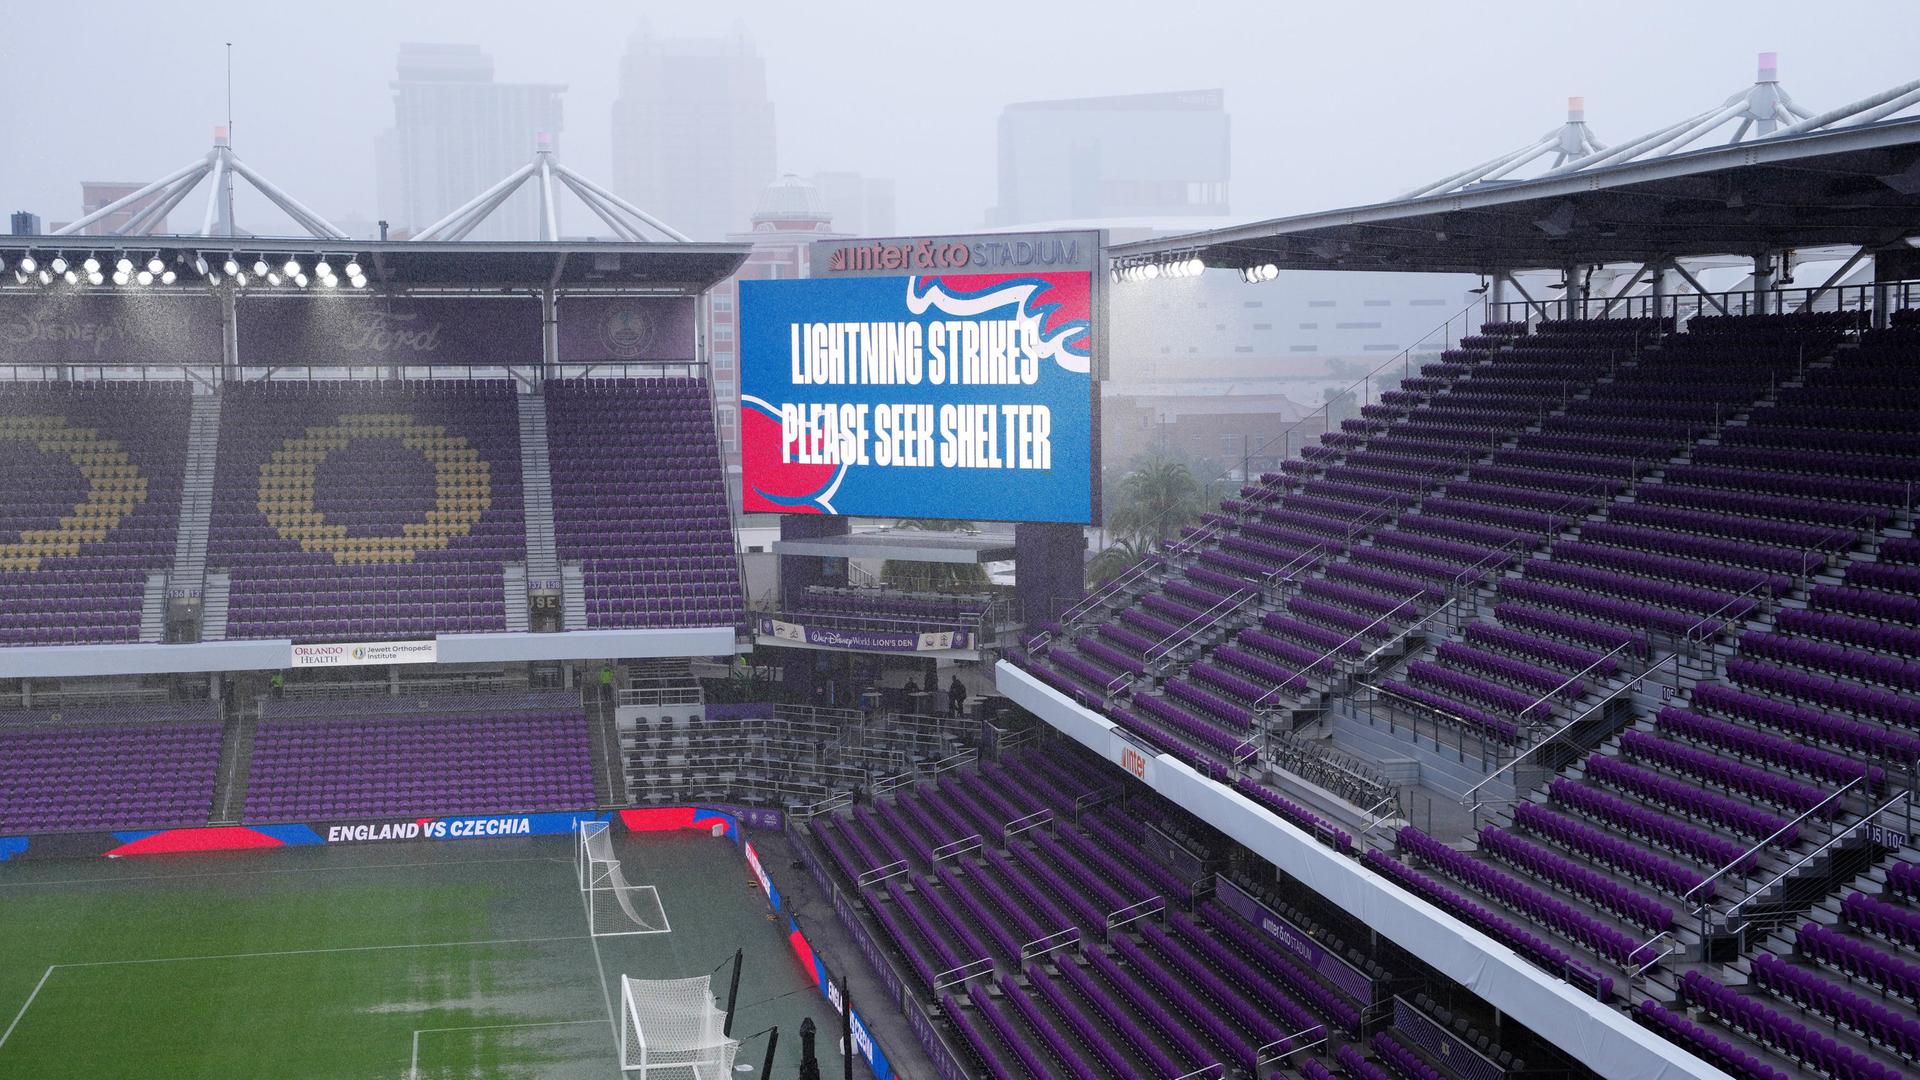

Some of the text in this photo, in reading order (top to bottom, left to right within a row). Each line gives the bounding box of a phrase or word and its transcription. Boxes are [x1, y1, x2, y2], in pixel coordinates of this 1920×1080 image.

[973, 239, 1079, 267] STADIUM
[343, 310, 441, 352] Ford
[790, 320, 1040, 385] LIGHTNING STRIKES
[781, 403, 1051, 470] PLEASE SEEK SHELTER
[169, 590, 202, 598] 136 13
[547, 581, 560, 589] 138
[392, 644, 432, 653] Orthopedic
[826, 632, 853, 648] Disney
[852, 636, 871, 646] World
[872, 639, 896, 647] LION'S
[897, 639, 913, 647] DEN
[294, 646, 343, 664] ORLANDO HEALTH
[367, 652, 397, 660] Institute
[327, 817, 530, 842] ENGLAND VS CZECHIA
